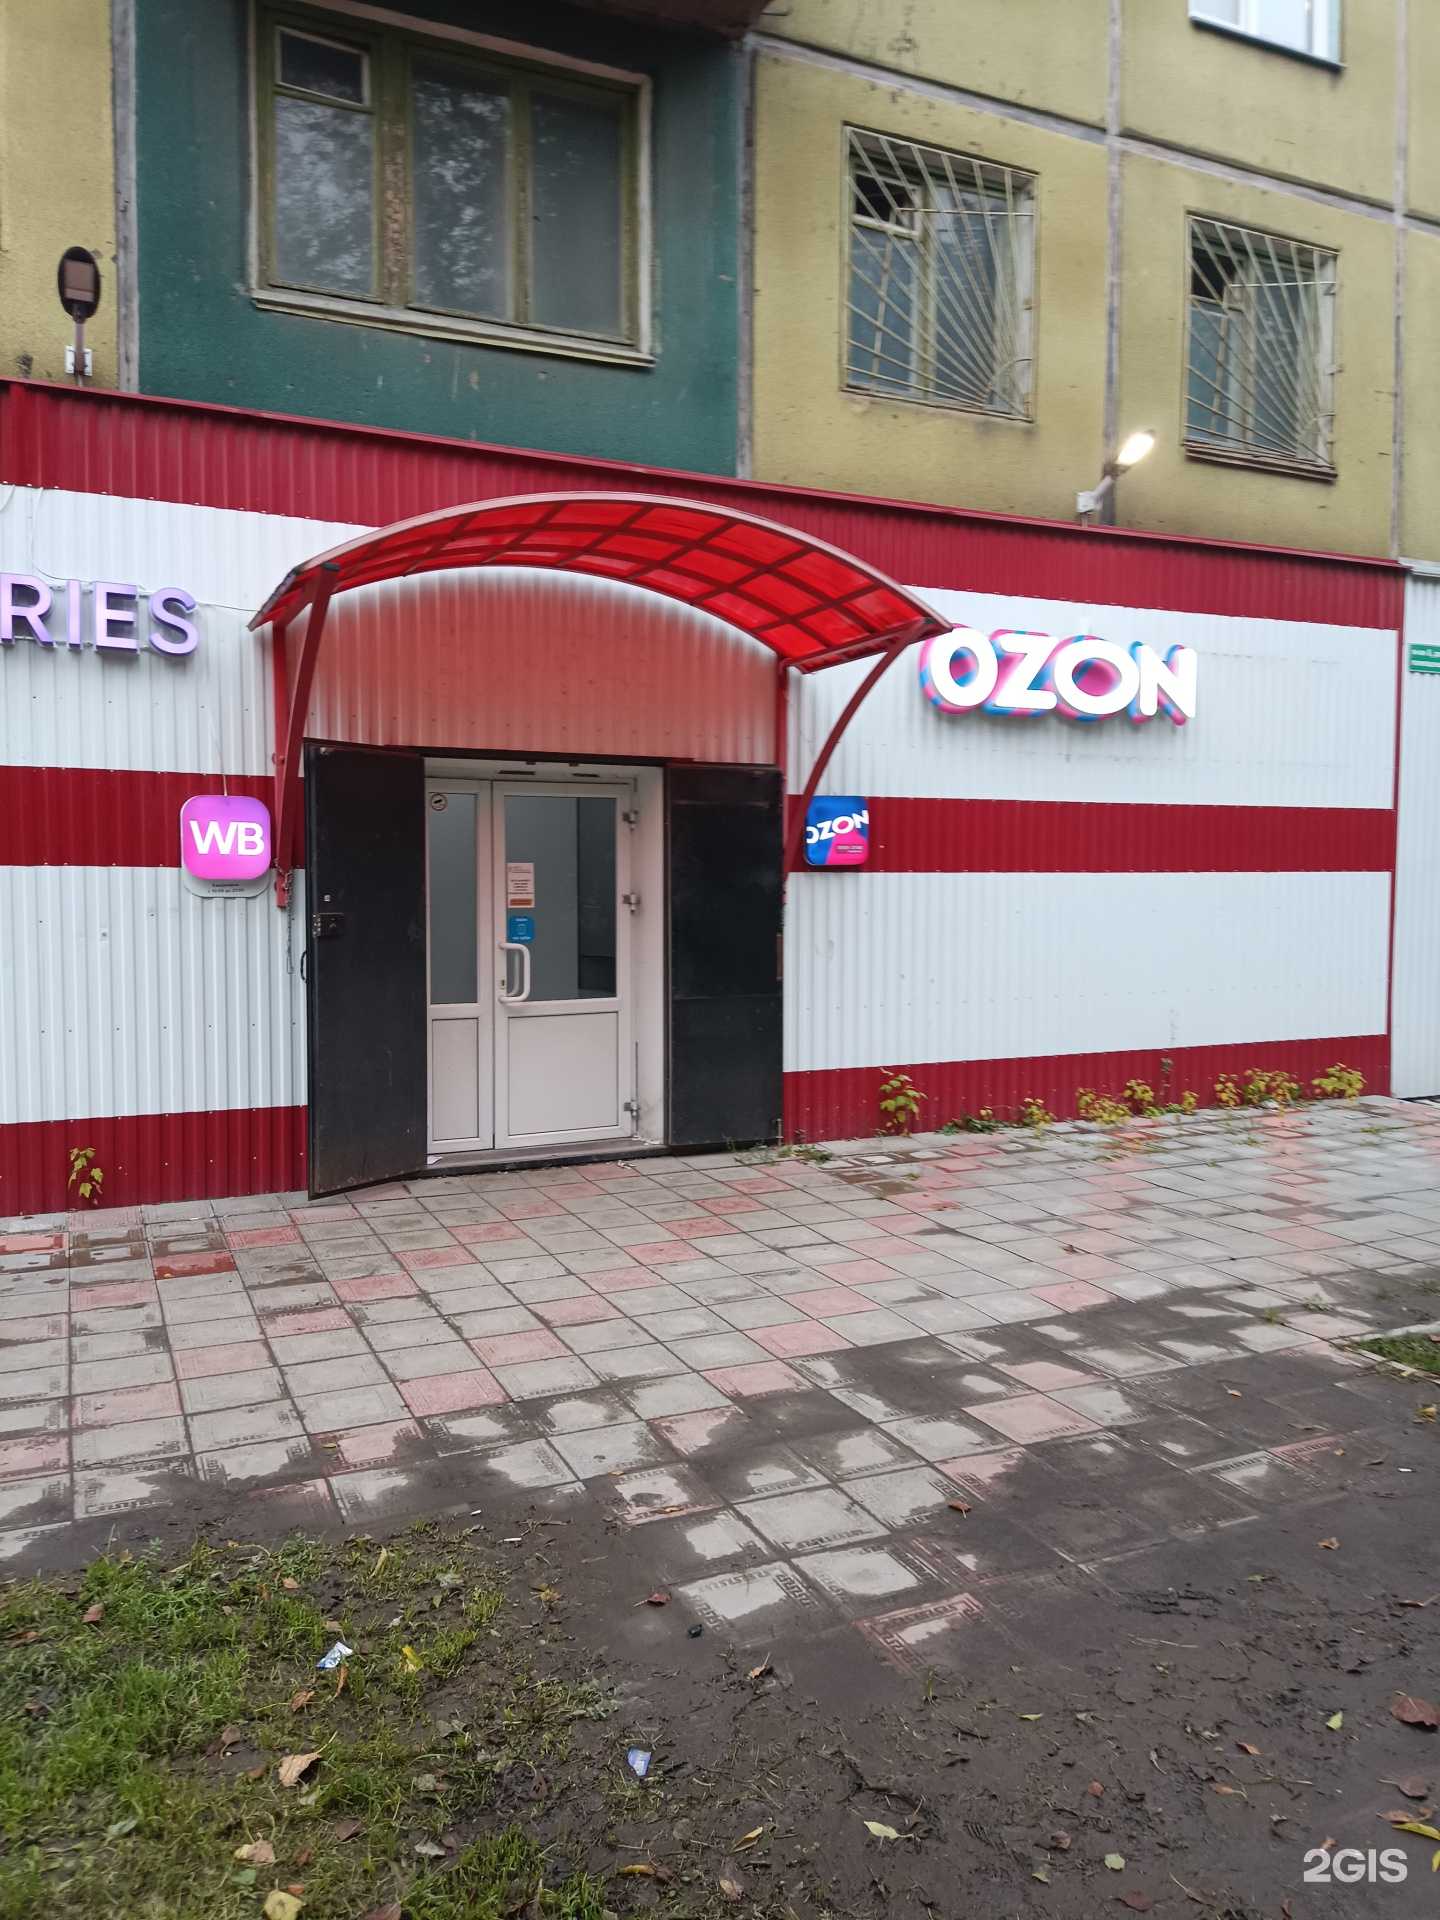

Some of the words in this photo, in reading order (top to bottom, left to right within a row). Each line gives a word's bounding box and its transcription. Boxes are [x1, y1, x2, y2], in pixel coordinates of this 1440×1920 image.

[0, 572, 199, 656] RIES
[921, 625, 1199, 725] OZON
[190, 820, 265, 856] WB
[806, 809, 869, 844] OZON
